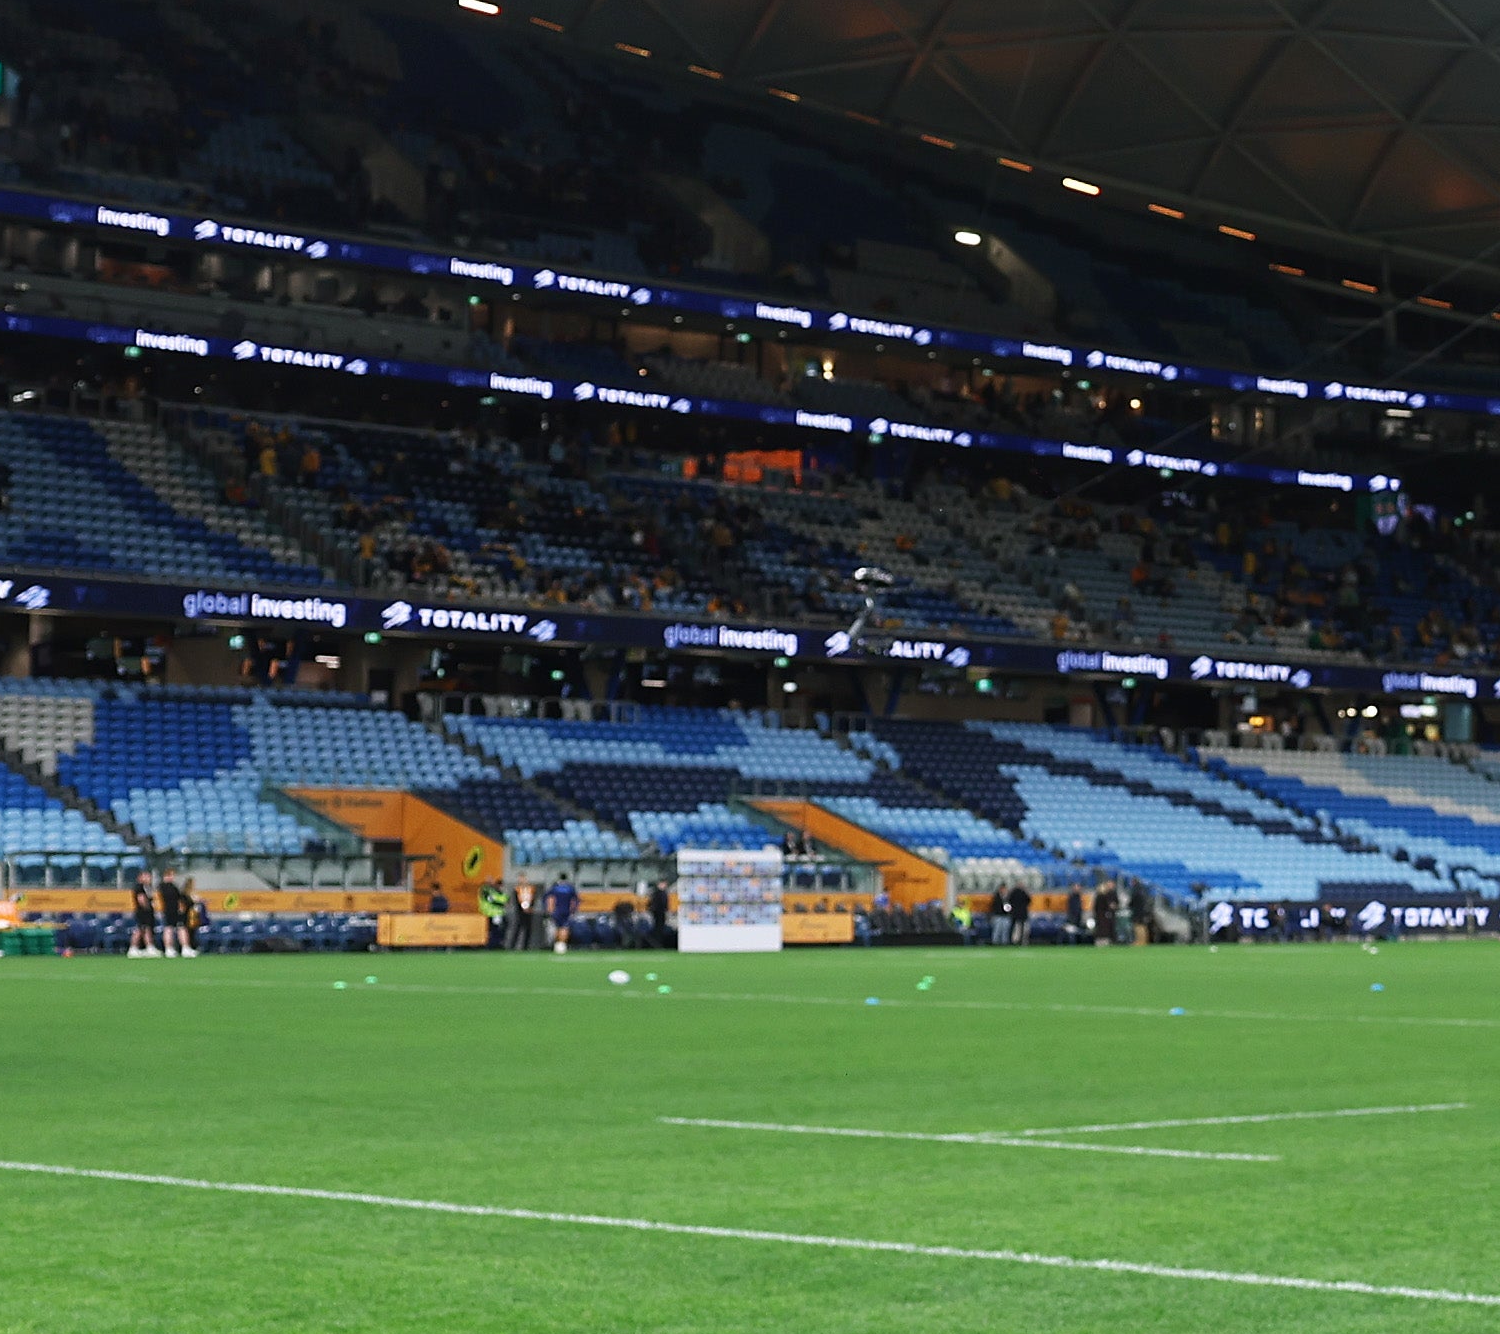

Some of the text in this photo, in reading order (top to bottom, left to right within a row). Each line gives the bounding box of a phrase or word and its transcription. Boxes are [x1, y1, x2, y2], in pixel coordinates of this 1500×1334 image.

[97, 205, 170, 237] investing
[221, 226, 304, 251] TOTALITY
[259, 346, 344, 369] TOTALITY
[183, 590, 346, 628] global investing
[418, 608, 527, 633] TOTALITY
[719, 626, 798, 657] investing
[1215, 660, 1291, 681] TOTALITY
